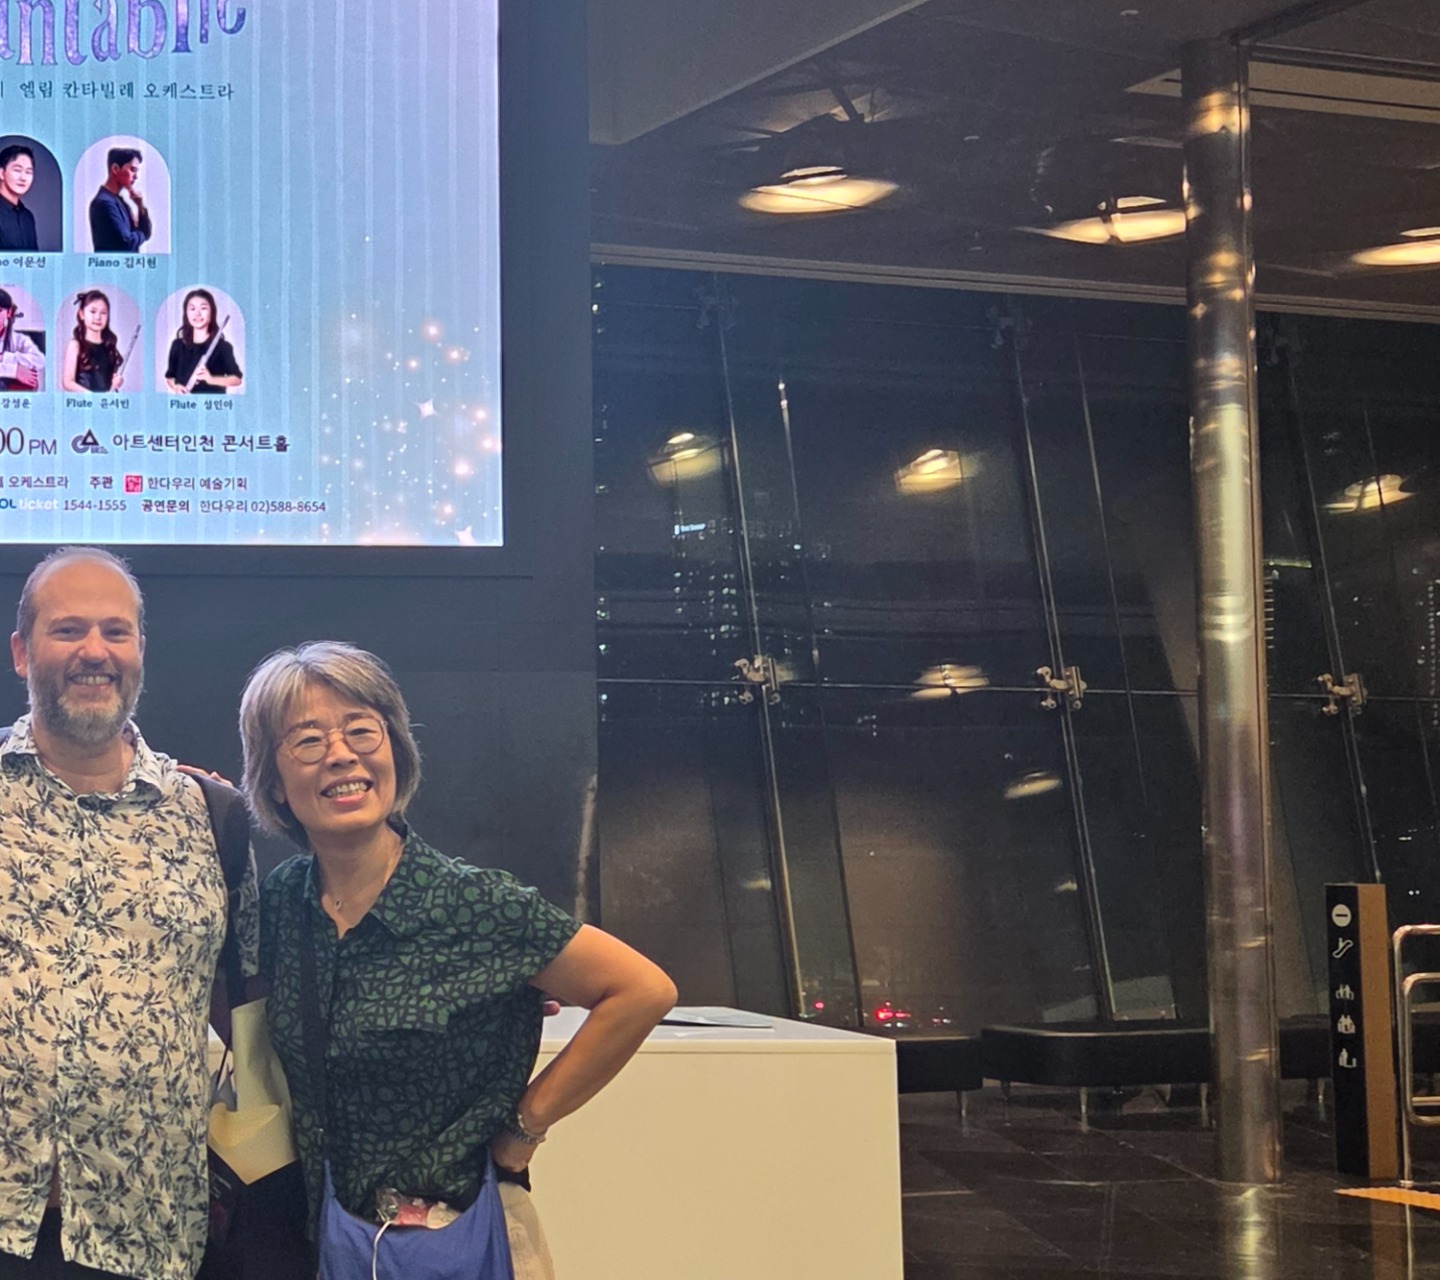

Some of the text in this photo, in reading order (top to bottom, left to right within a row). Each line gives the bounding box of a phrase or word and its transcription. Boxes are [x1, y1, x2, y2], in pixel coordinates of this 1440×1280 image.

[20, 80, 53, 99] 엘림
[62, 81, 134, 99] 칸타빌레
[143, 82, 234, 100] 오케스트라
[88, 257, 120, 267] Piano
[66, 399, 92, 408] Flute
[170, 399, 196, 410] Flute
[28, 439, 57, 455] PM
[113, 433, 214, 452] 아트센터인천
[221, 435, 290, 453] 콘서트홀
[9, 476, 68, 489] 오케스트라
[89, 476, 114, 490] 주관
[148, 477, 195, 490] 한다우리
[200, 477, 248, 490] 예술기획
[19, 498, 58, 510] ticket
[63, 499, 127, 511] 1544-1555
[142, 499, 326, 515] 공연문의 한다우리 02)588-8654
